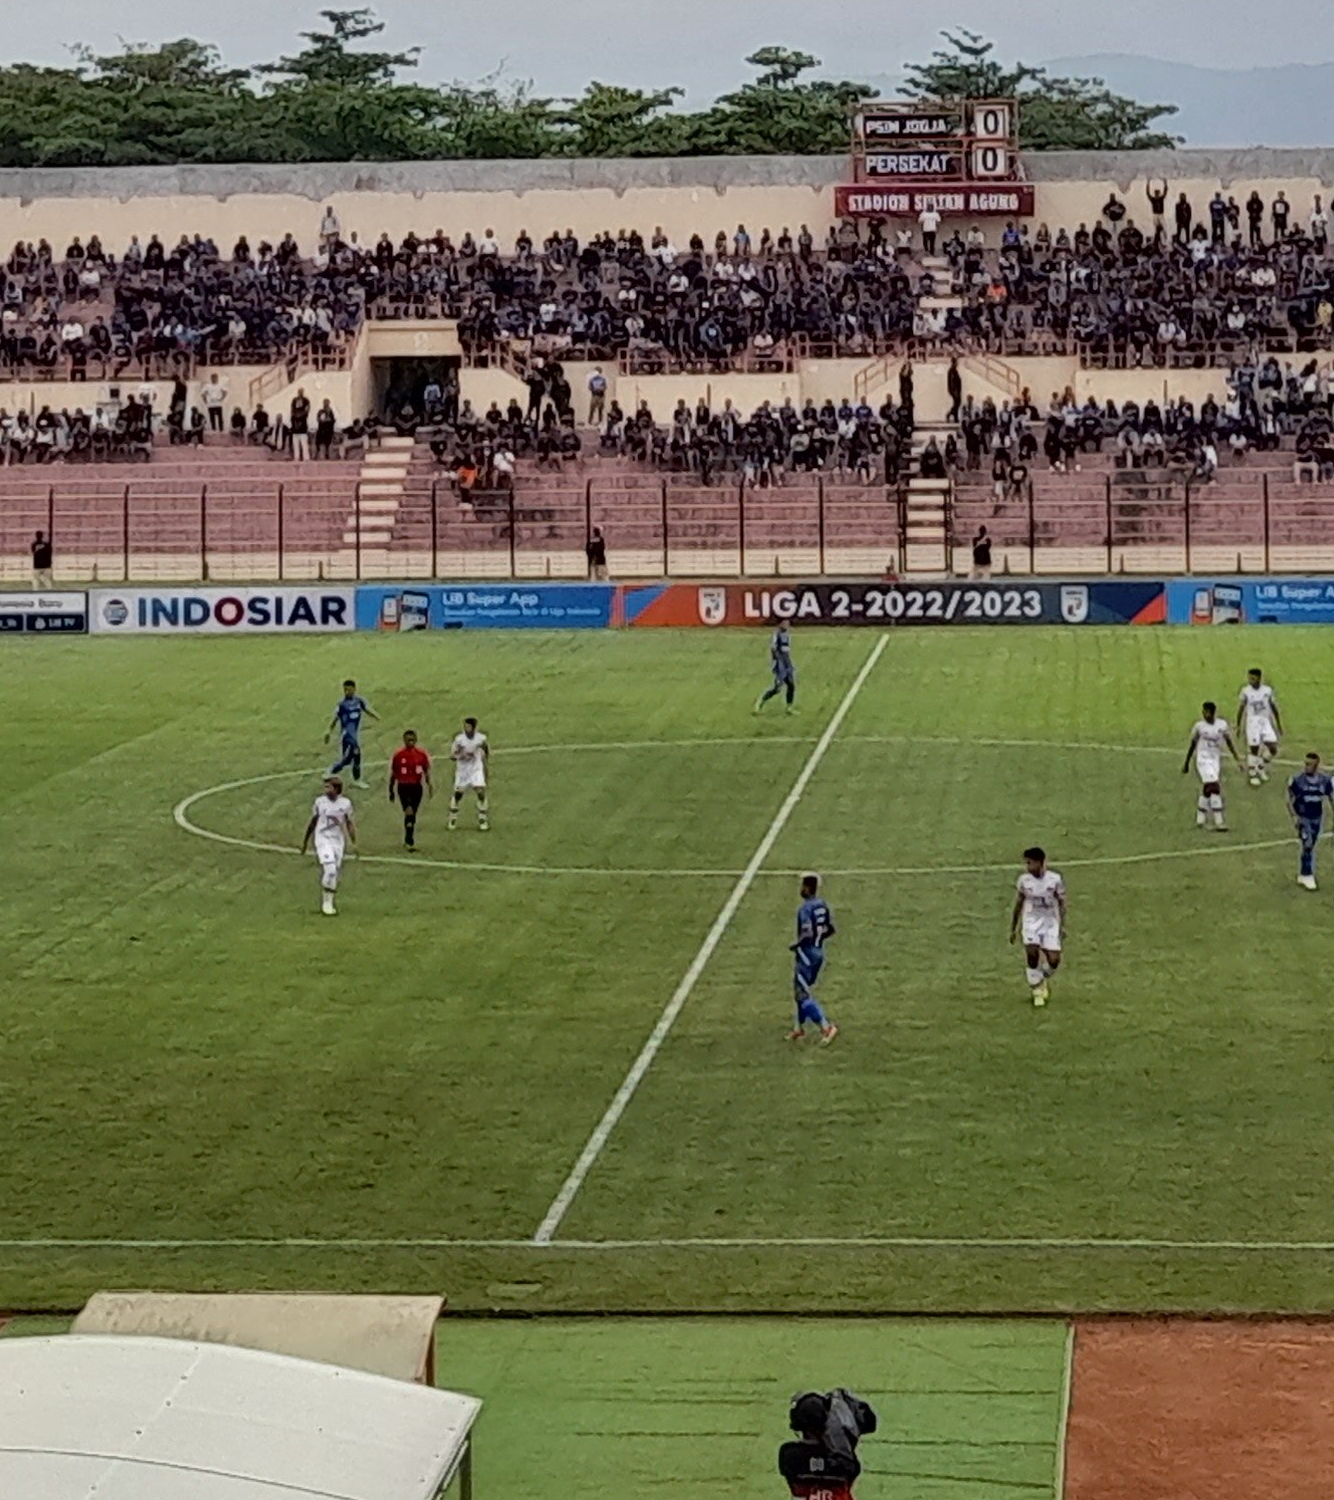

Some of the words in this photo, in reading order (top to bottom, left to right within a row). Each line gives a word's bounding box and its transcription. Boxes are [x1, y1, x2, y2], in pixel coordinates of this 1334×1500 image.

[983, 109, 999, 135] 0
[866, 153, 949, 174] PERSEKAT
[981, 147, 998, 172] 0
[848, 193, 910, 212] STADION
[969, 192, 1019, 212] AGUNG
[137, 595, 348, 627] INDOSIAR
[509, 592, 539, 607] App
[743, 591, 822, 618] LIGA
[830, 590, 1042, 619] 2-2022/2023
